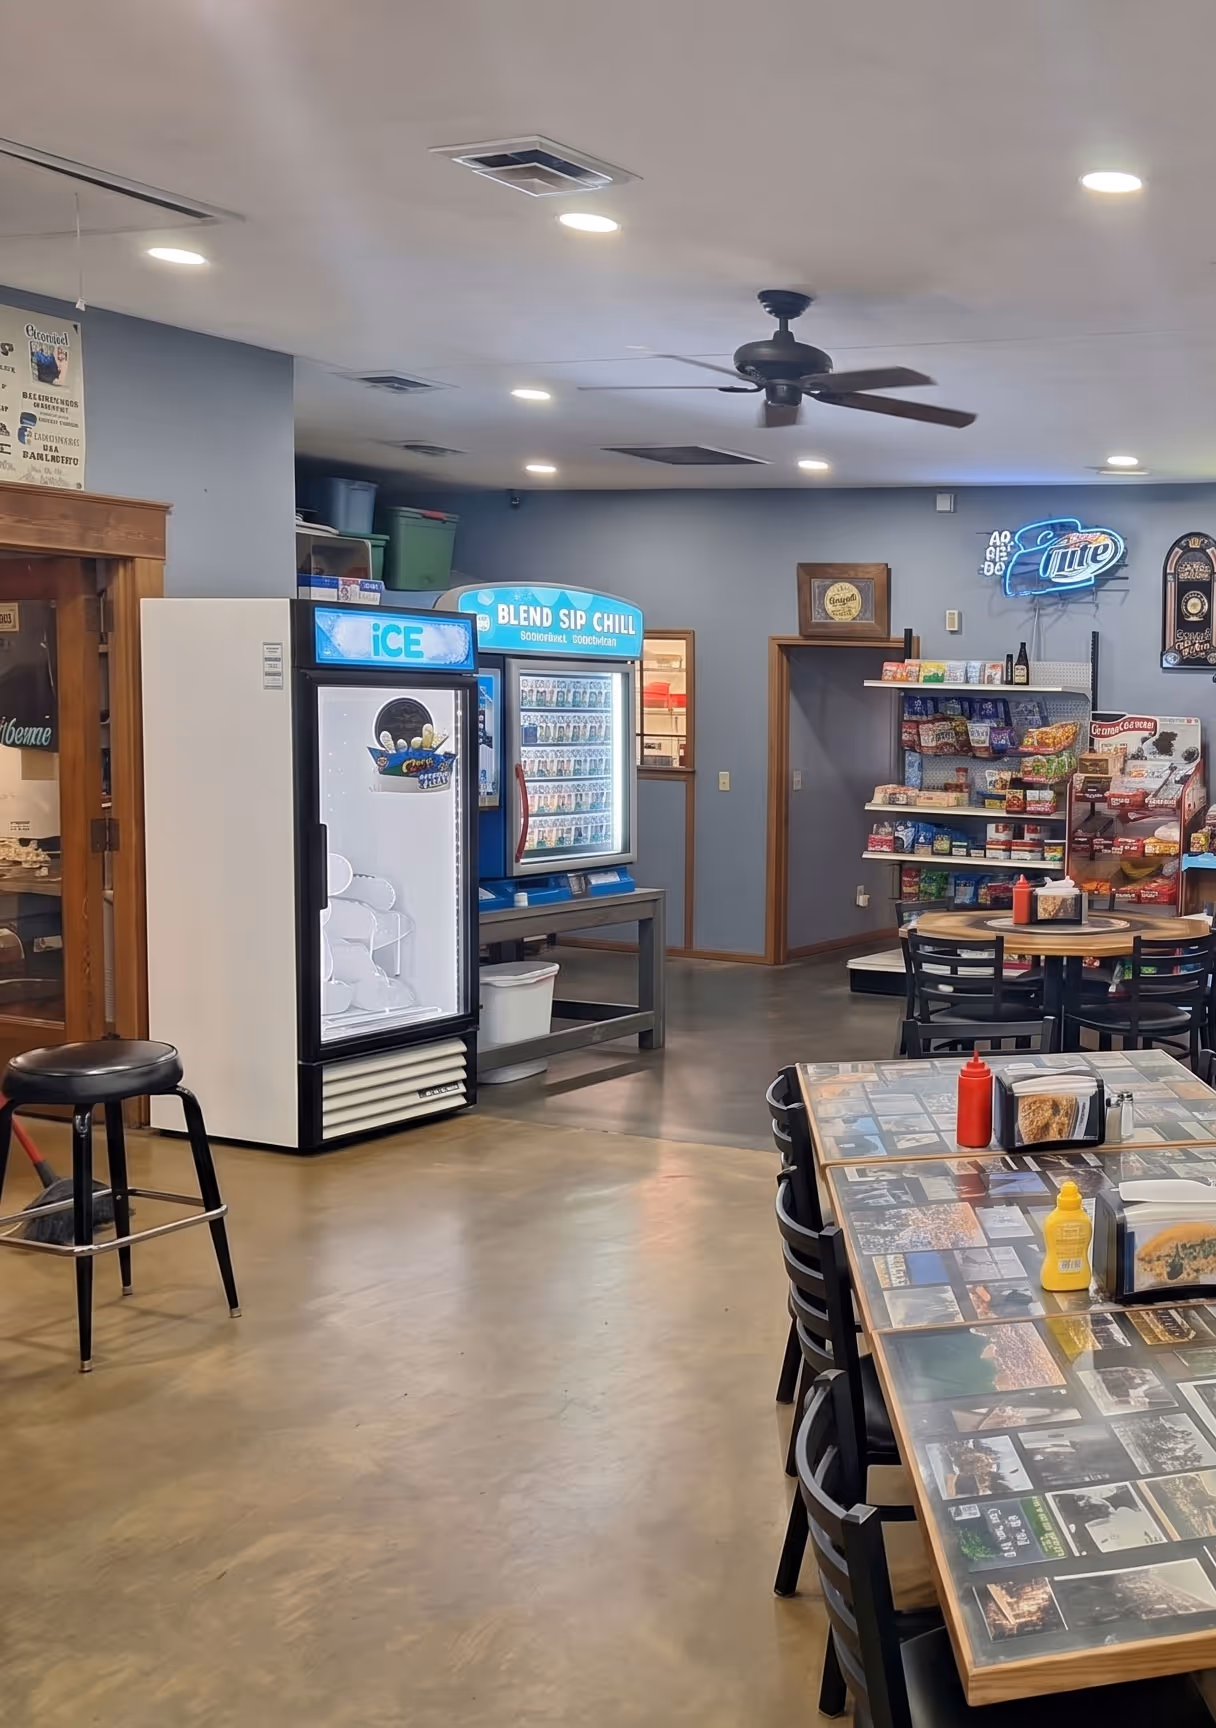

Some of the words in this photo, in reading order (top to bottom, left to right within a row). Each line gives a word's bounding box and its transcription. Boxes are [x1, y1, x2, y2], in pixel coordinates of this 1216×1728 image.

[497, 603, 553, 629] BLEND
[559, 608, 587, 630] SIP
[592, 611, 636, 636] CHILL
